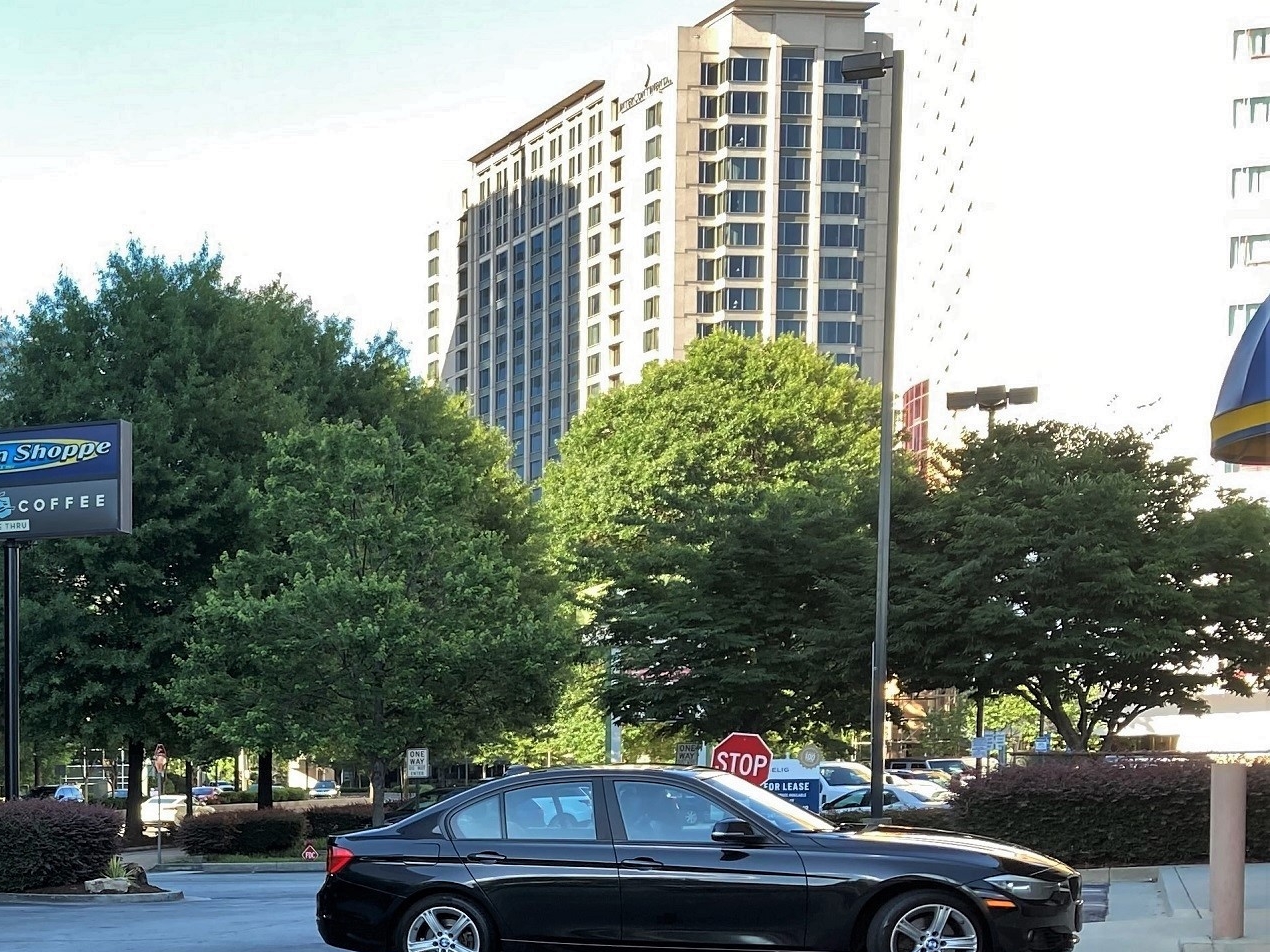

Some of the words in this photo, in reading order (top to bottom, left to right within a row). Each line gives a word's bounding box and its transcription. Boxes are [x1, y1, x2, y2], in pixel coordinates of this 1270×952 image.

[13, 441, 112, 461] Shoppe
[18, 493, 106, 513] COFFEE
[5, 522, 27, 530] THRU
[410, 750, 425, 758] ONE
[715, 752, 768, 777] STOP
[763, 782, 780, 791] FOR
[782, 782, 810, 791] LEASE
